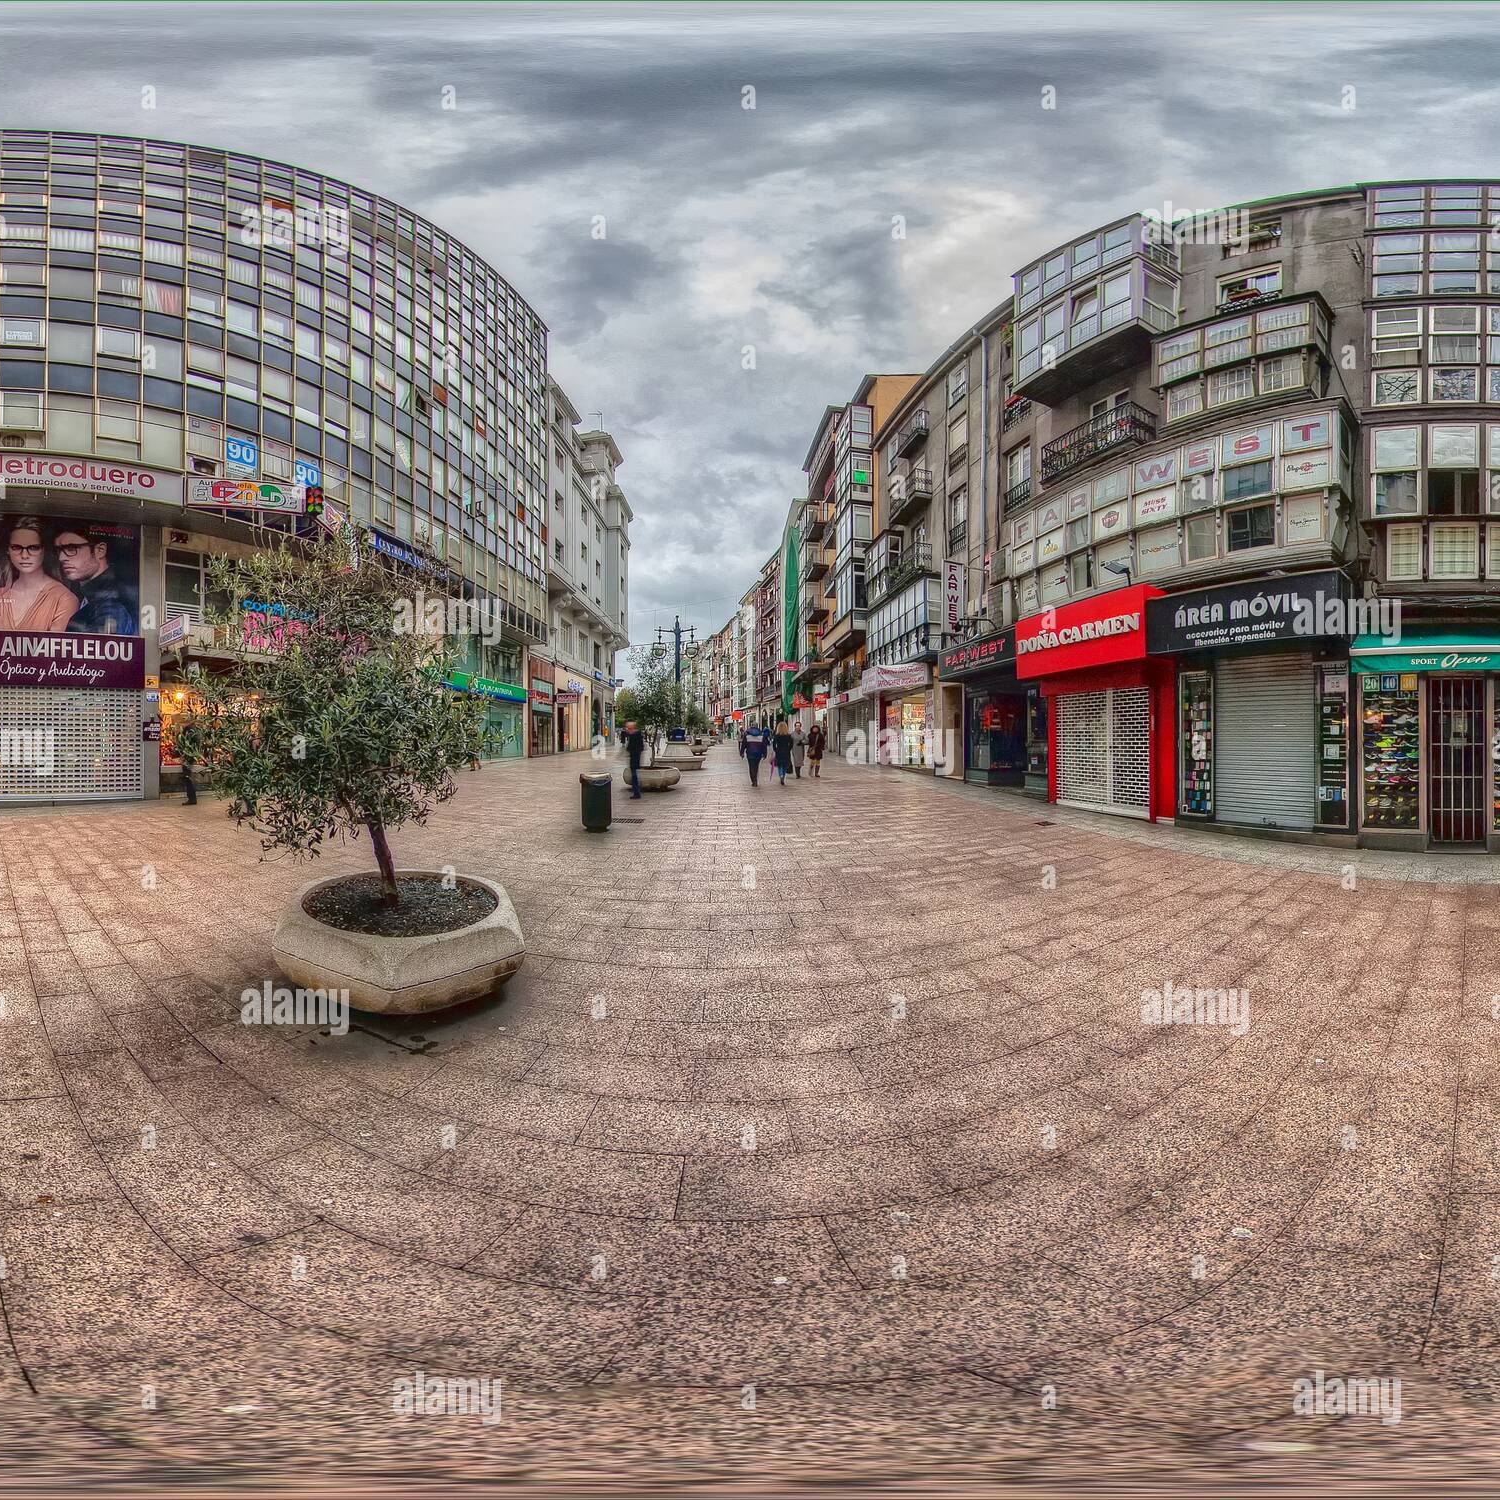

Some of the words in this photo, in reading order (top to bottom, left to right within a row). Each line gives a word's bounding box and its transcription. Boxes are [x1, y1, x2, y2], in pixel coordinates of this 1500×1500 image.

[228, 441, 255, 463] 90
[295, 464, 318, 485] 90
[90, 484, 135, 495] servicios
[947, 564, 959, 591] FAR
[946, 593, 959, 633] WEST
[1174, 601, 1224, 628] ÁREA
[1230, 592, 1301, 620] MÓVIL
[1017, 629, 1059, 655] DOÑA
[1059, 612, 1140, 646] CARMEN
[1186, 627, 1228, 640] accesorios
[1229, 624, 1250, 637] para
[1251, 620, 1286, 632] móviles
[1194, 635, 1230, 647] liberación
[1235, 631, 1276, 644] reparación
[0, 657, 37, 680] Óptico
[38, 668, 46, 682] y
[48, 661, 106, 684] Audiólogo
[1440, 653, 1491, 668] Open
